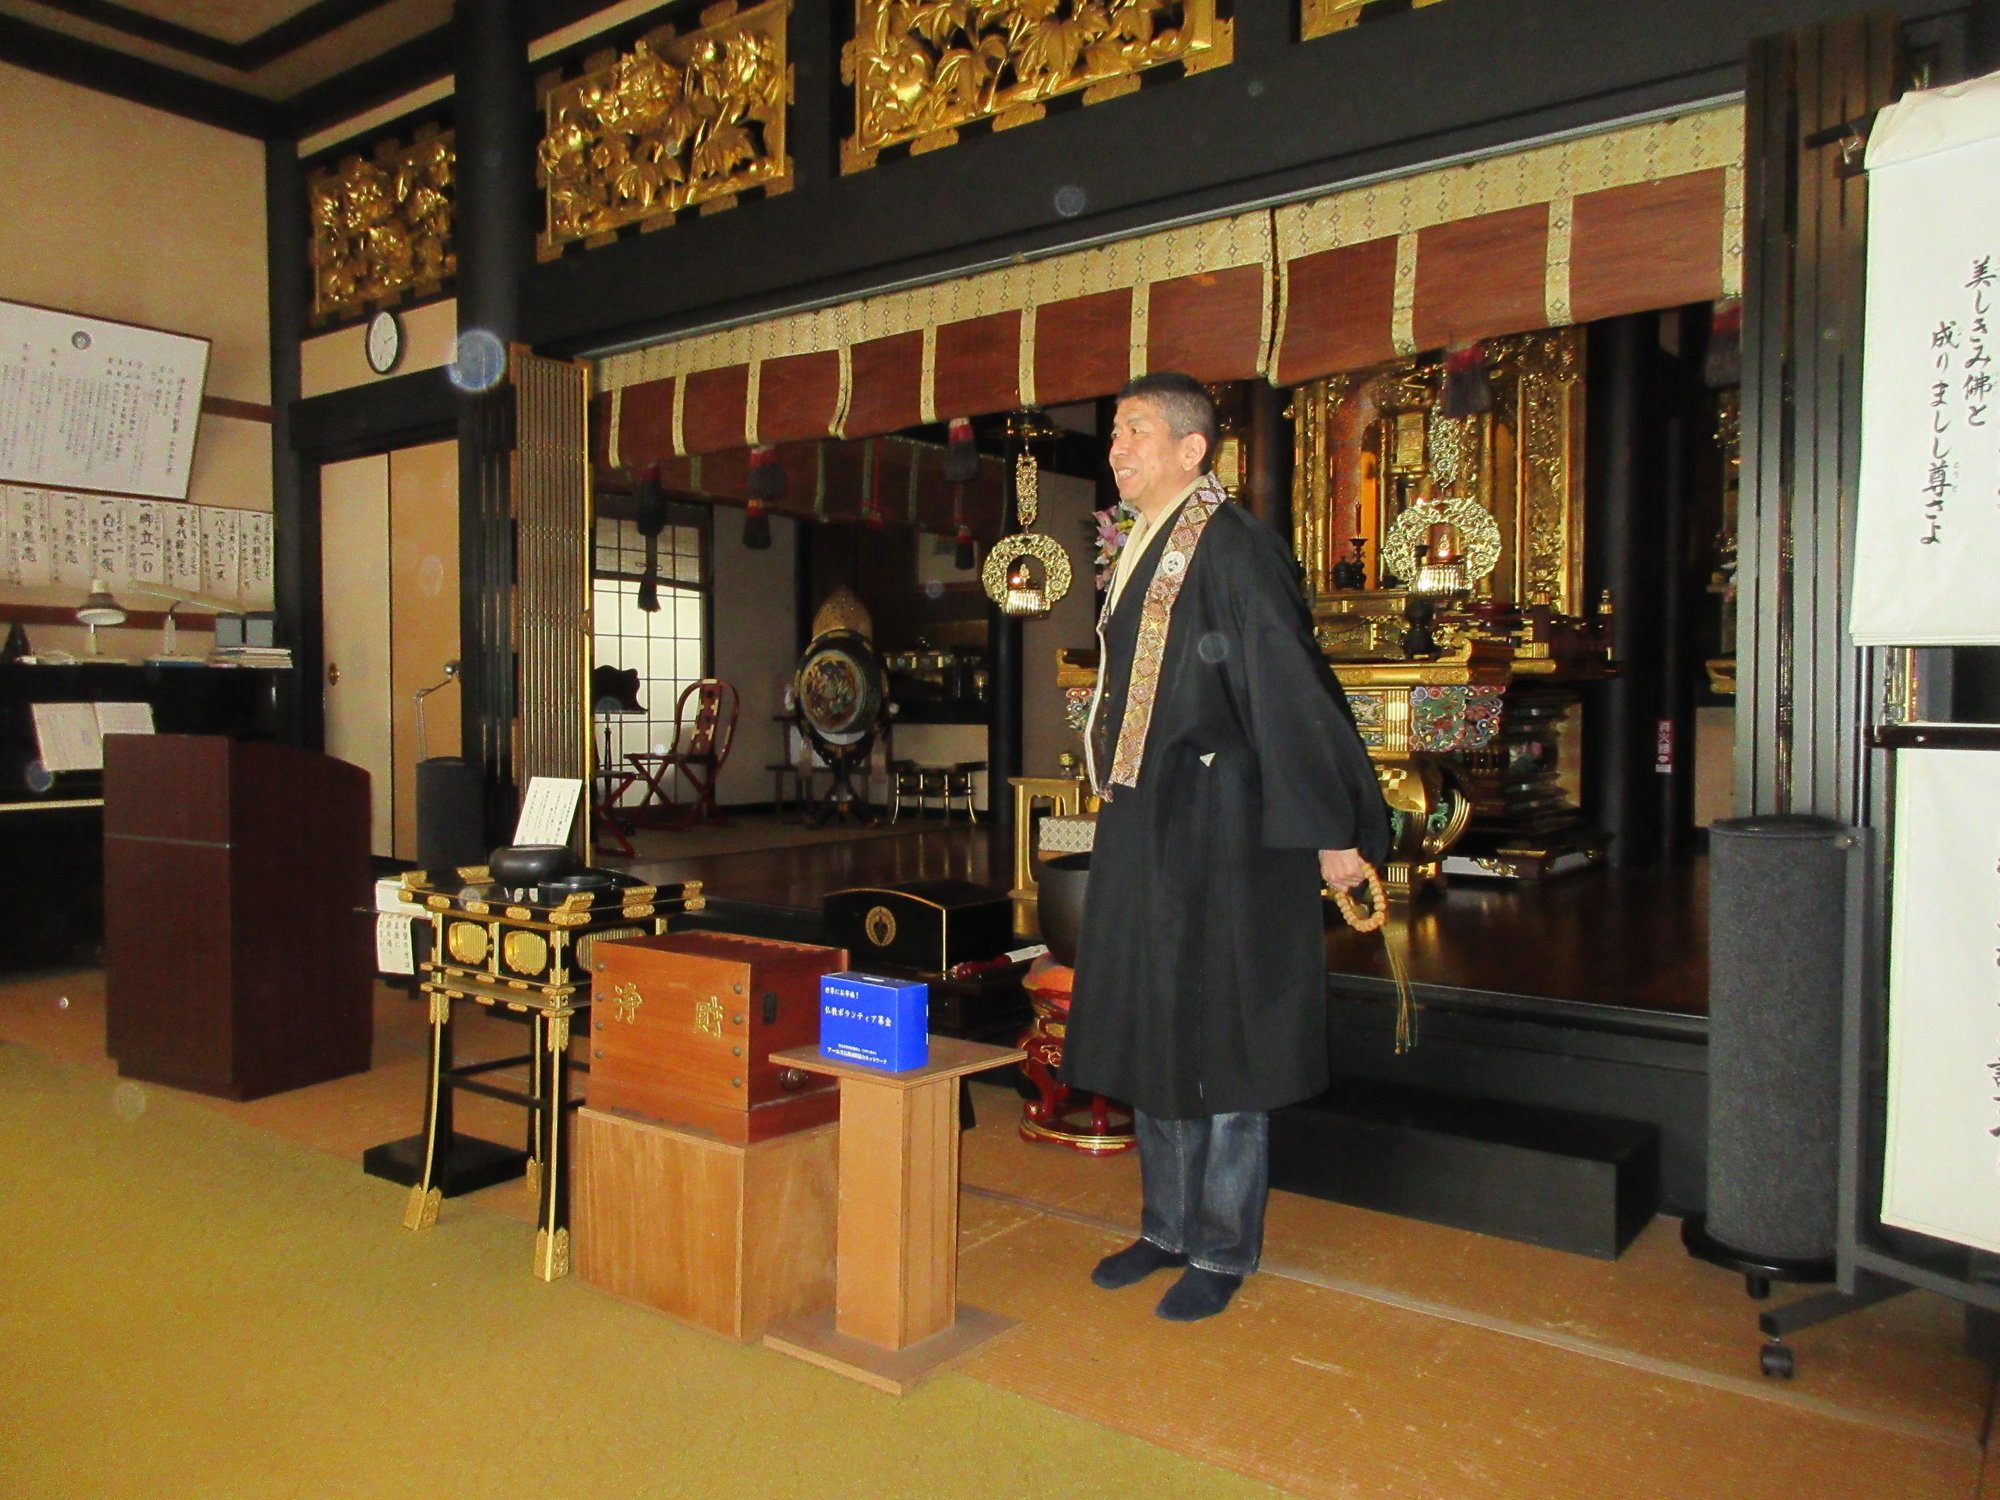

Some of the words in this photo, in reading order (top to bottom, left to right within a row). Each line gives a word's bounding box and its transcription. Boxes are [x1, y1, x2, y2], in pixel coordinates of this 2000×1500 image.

[1961, 255, 1997, 427] 美しきみ佛と
[1919, 320, 1960, 545] 成りましし尊さよ
[824, 1005, 893, 1028] 仏教ボランティア基金
